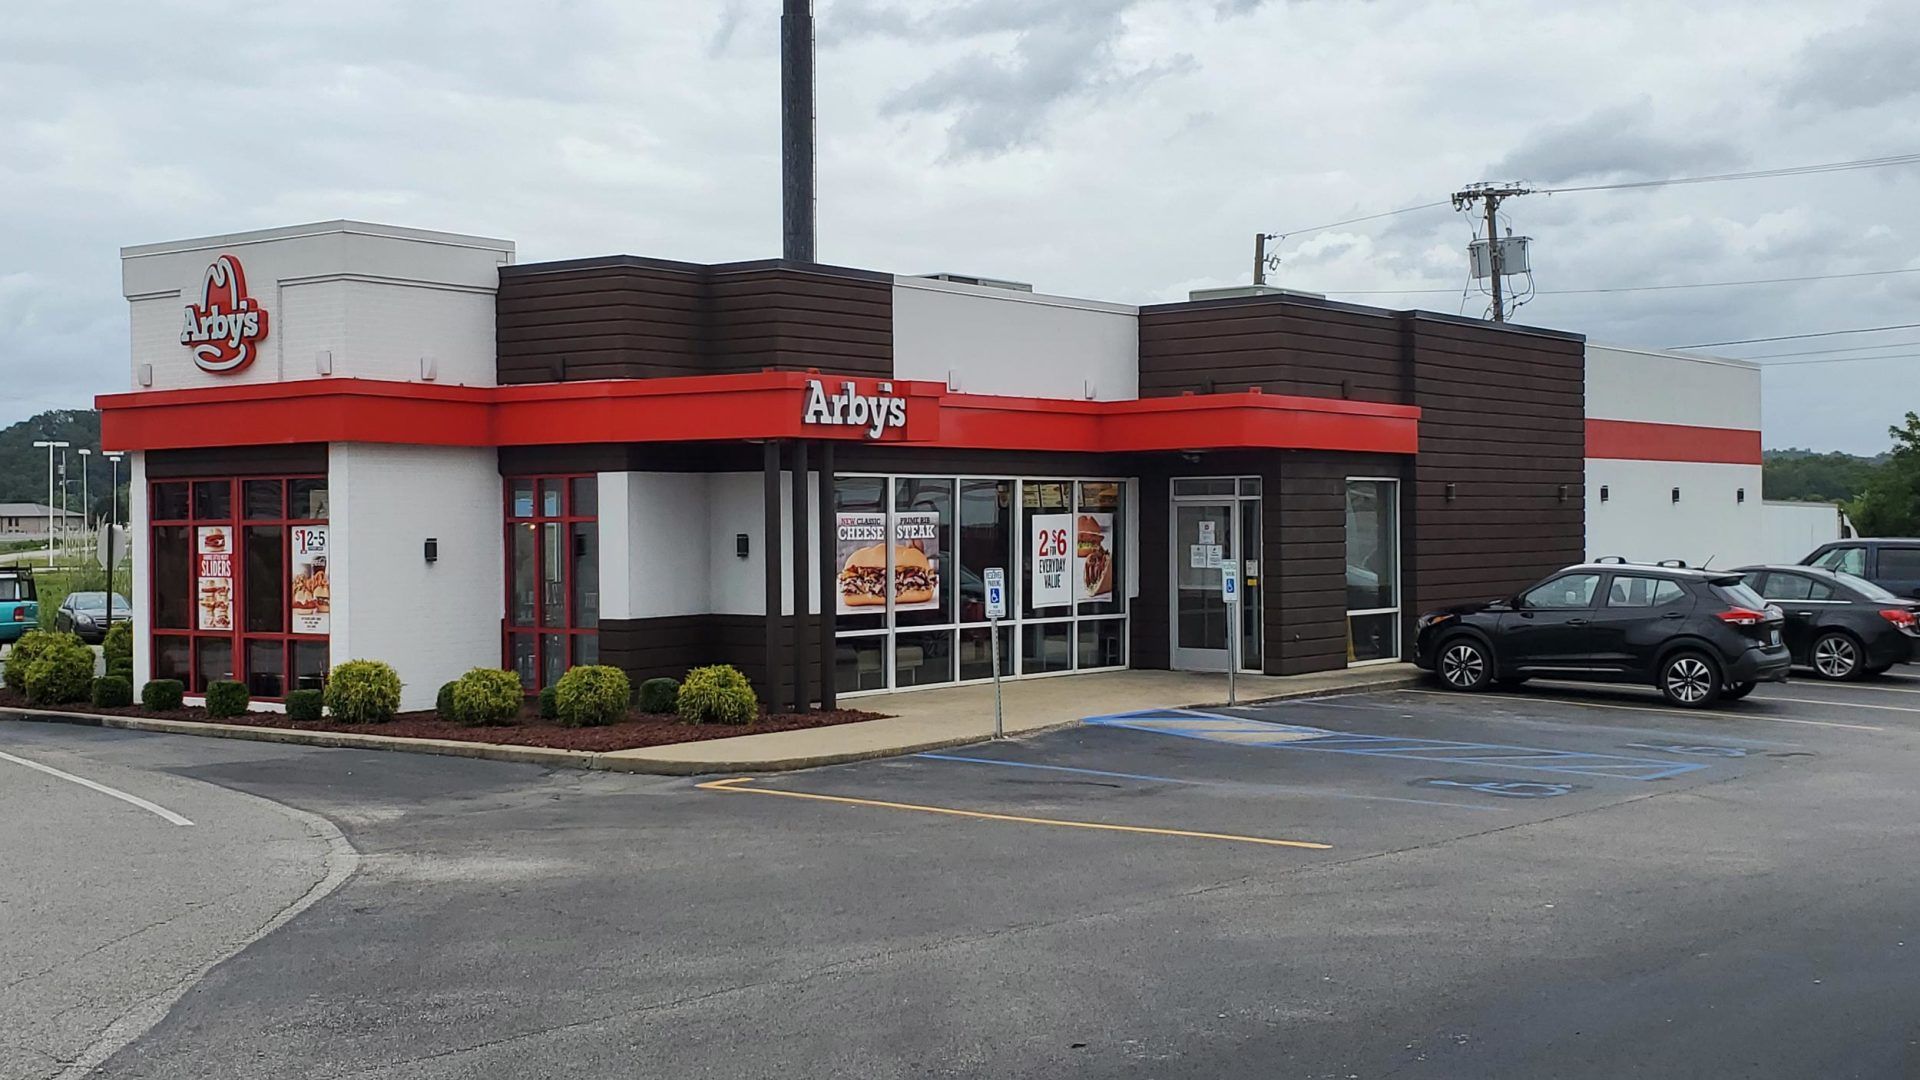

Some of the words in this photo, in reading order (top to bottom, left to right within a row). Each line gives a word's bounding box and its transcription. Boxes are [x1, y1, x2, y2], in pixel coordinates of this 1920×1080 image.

[181, 300, 259, 348] Arby's
[804, 380, 906, 439] Arby's
[841, 517, 856, 525] NEW
[857, 516, 881, 525] CLASSIC
[900, 517, 919, 525] PRIME
[307, 530, 326, 546] 2-5
[838, 526, 885, 541] CHEESE
[896, 525, 935, 539] STEAK
[201, 560, 231, 577] SLIDERS
[1039, 558, 1066, 574] EVERYDAY
[1044, 574, 1061, 589] VALUE
